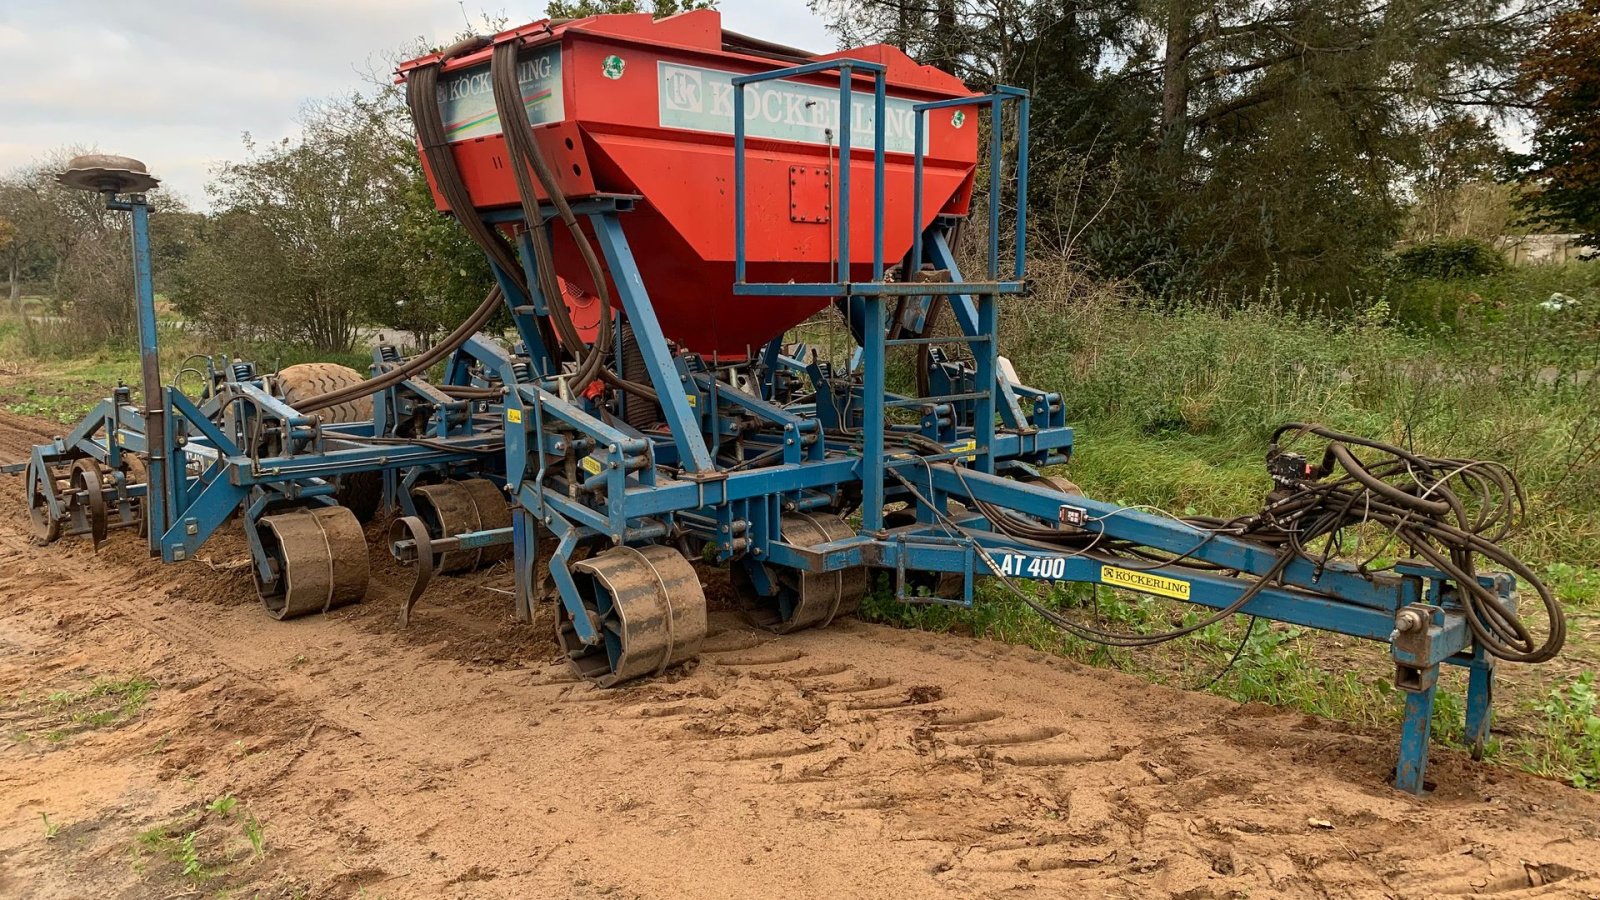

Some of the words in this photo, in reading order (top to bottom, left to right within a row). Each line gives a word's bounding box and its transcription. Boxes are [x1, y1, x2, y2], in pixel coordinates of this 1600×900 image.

[1001, 554, 1025, 576] AT
[1027, 556, 1066, 579] 400
[1115, 570, 1188, 594] KÖCKERLING
